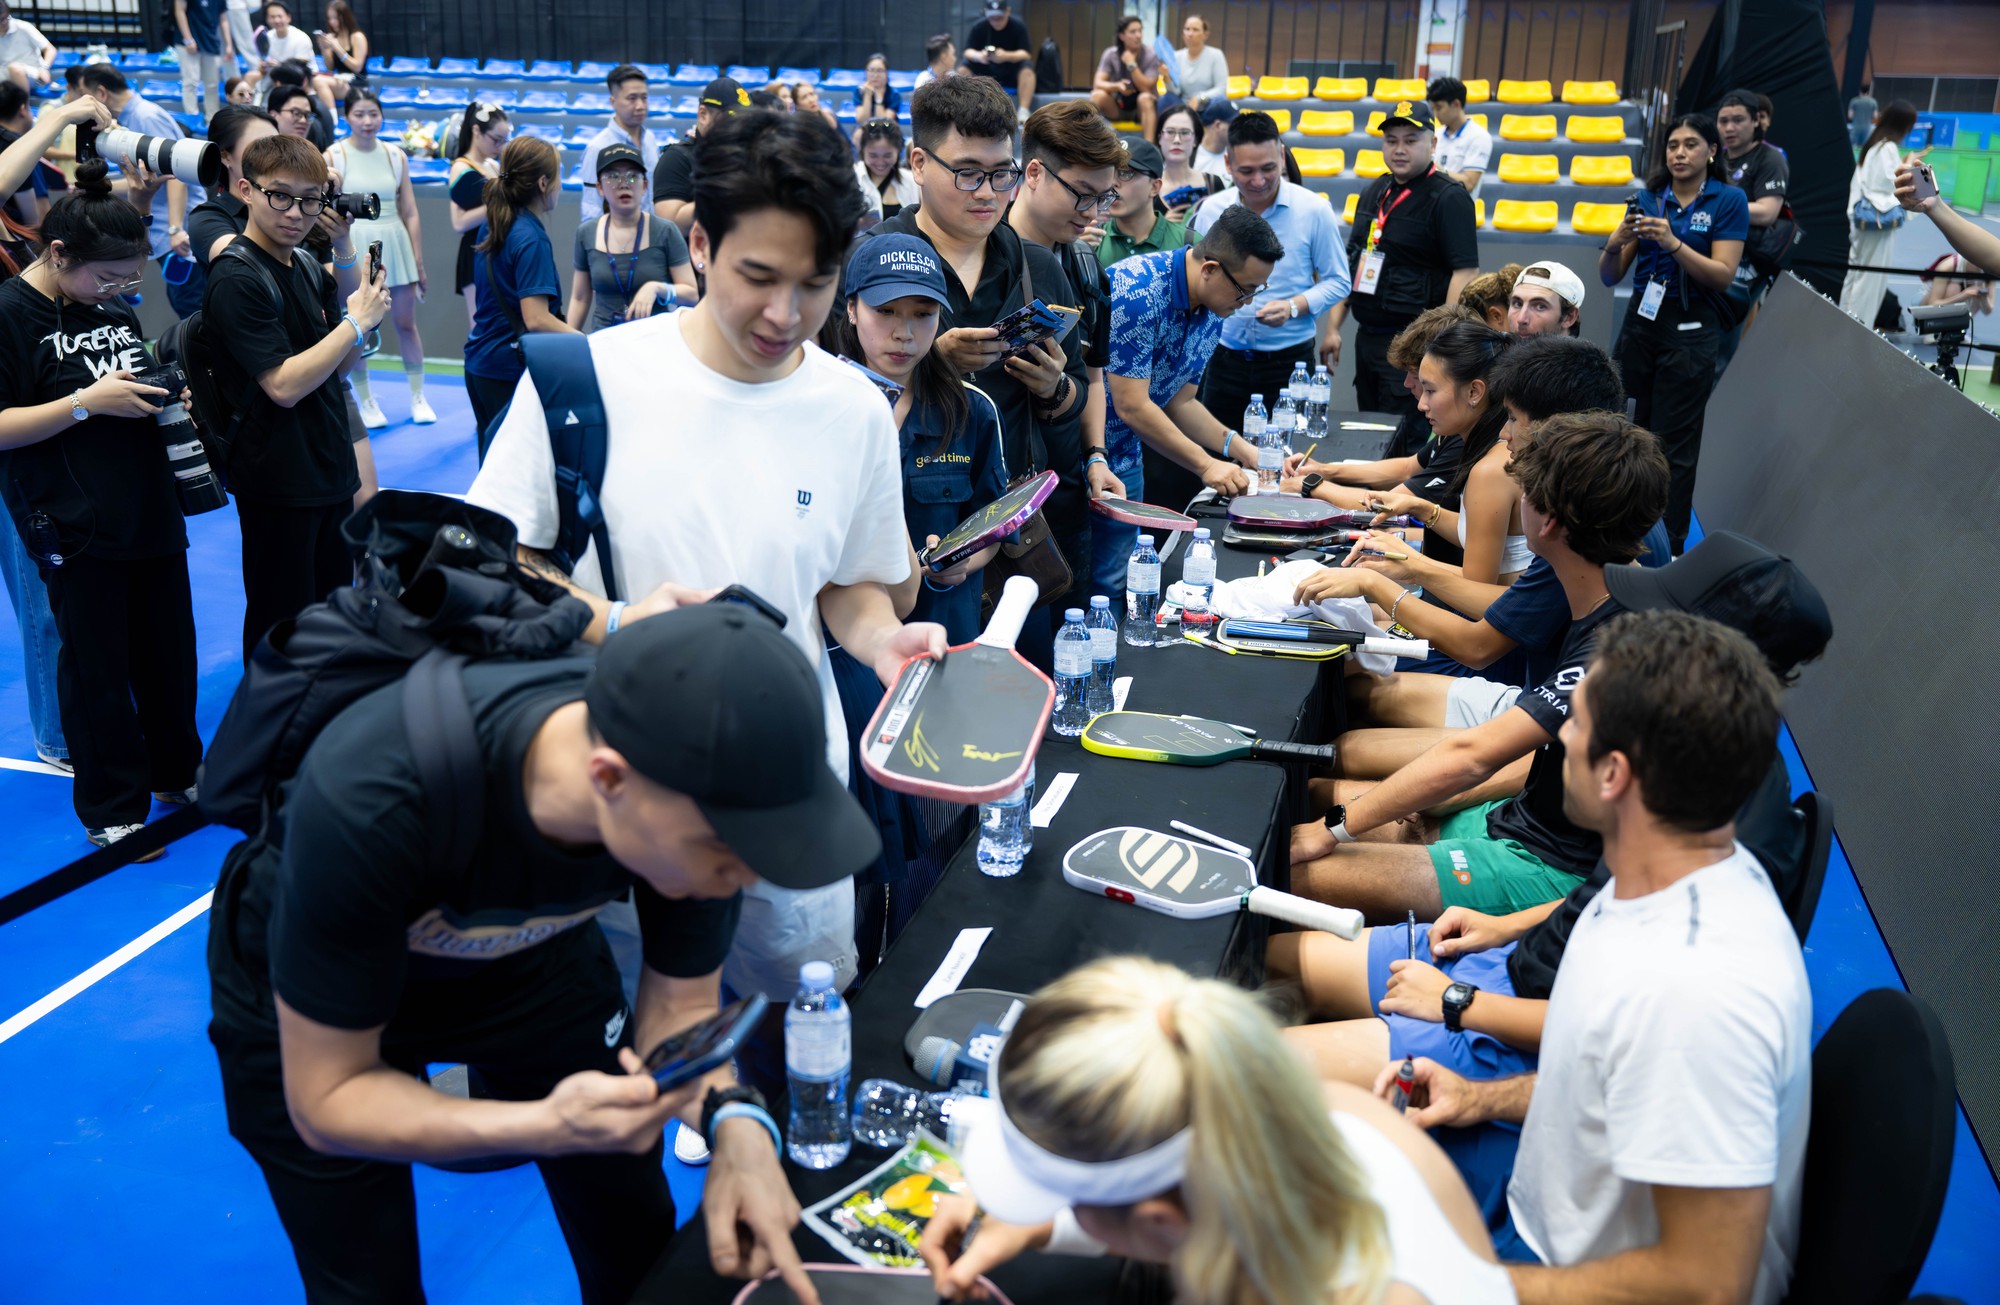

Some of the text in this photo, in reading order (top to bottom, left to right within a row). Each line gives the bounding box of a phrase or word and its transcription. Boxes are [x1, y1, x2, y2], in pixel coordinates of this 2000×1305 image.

[891, 263, 930, 275] AUTHENTIC
[40, 325, 142, 361] TOGETHE
[83, 347, 148, 381] WE
